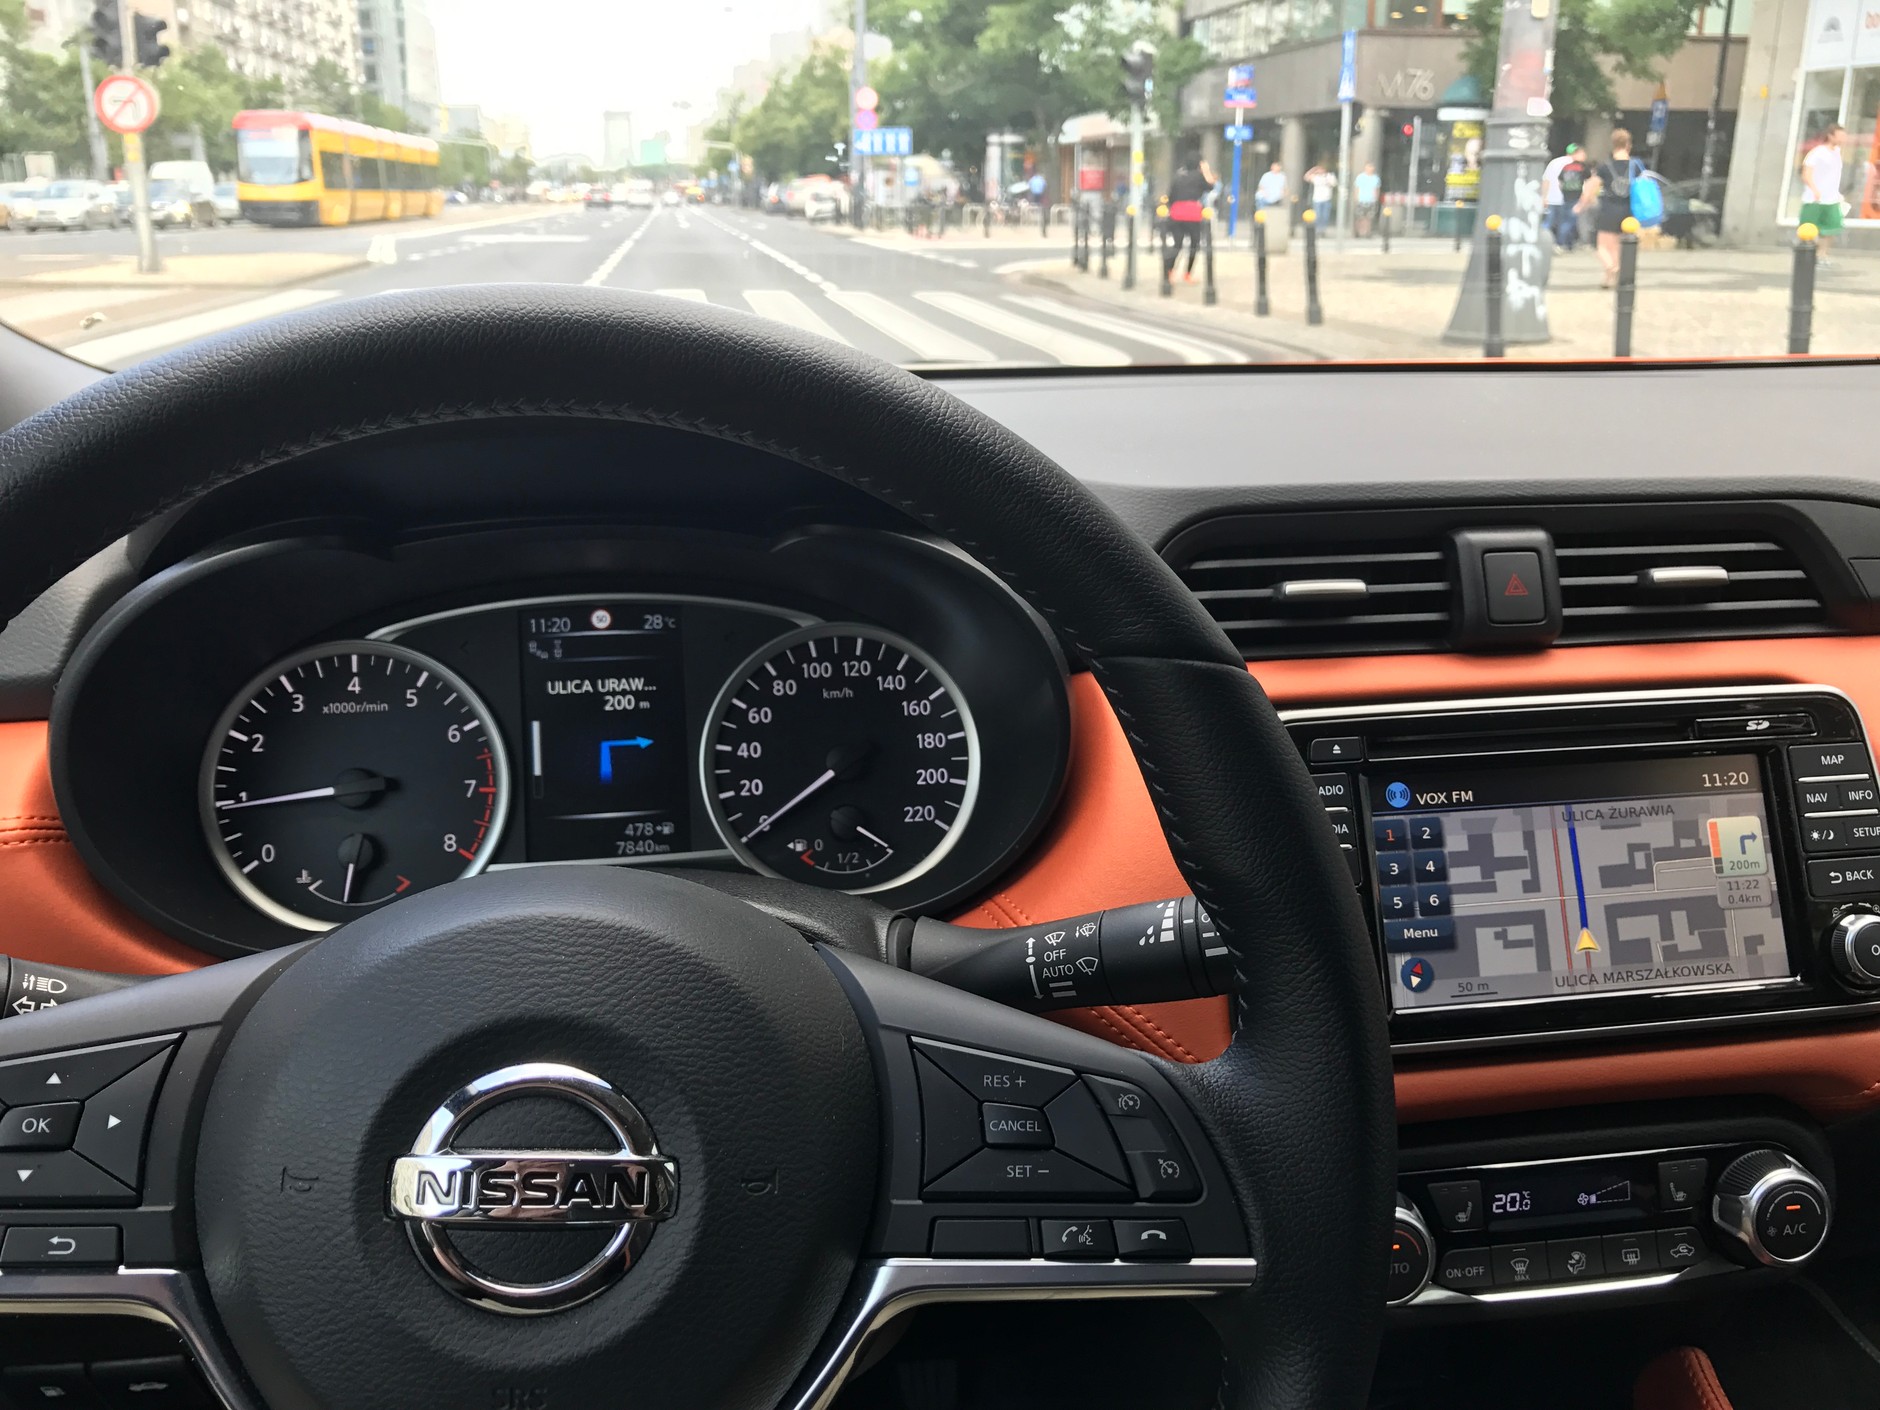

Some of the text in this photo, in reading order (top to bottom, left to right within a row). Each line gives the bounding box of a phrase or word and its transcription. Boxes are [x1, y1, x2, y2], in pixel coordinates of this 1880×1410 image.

[530, 617, 571, 633] 11:20
[801, 662, 832, 679] 100
[842, 660, 871, 677] 120
[347, 676, 361, 694] 4
[547, 680, 593, 695] ULICA
[772, 680, 797, 696] 80
[876, 675, 906, 691] 140
[406, 689, 418, 708] 5
[822, 688, 853, 699] km/h
[292, 694, 305, 712] 3
[322, 701, 388, 715] x1000r/min
[604, 695, 650, 711] 200 m
[901, 700, 931, 717] 160
[748, 707, 772, 724] 60
[447, 725, 461, 743] 6
[916, 733, 946, 749] 180
[251, 733, 264, 752] 2
[737, 742, 762, 759] 40
[1821, 755, 1844, 766] MAP
[916, 768, 948, 786] 200
[1701, 771, 1750, 787] 11:20
[464, 779, 476, 798] 7
[739, 779, 763, 796] 20
[1318, 785, 1344, 796] ADIO
[239, 791, 247, 802] 1
[1416, 790, 1474, 805] VOX FM
[1806, 793, 1828, 803] NAV
[1848, 790, 1873, 801] INFO
[904, 805, 935, 822] 220
[1561, 804, 1675, 822] ULICA ŻURAWIA
[624, 822, 654, 837] 478
[1332, 823, 1349, 834] DIA
[1386, 829, 1395, 841] 1
[1421, 827, 1431, 839] 2
[443, 834, 457, 852] 8
[814, 839, 824, 850] 0
[261, 844, 275, 863] 0
[837, 852, 859, 864] 1/2
[1389, 863, 1399, 875] 3
[1425, 860, 1436, 872] 4
[1729, 859, 1761, 872] 200m
[1845, 869, 1874, 881] BACK
[1726, 879, 1760, 891] 11:22
[1393, 897, 1403, 909] 5
[1429, 894, 1440, 906] 6
[1727, 893, 1762, 905] 0.4km
[1403, 927, 1439, 940] Menu
[1043, 949, 1067, 962] OFF
[1871, 944, 1880, 956] O
[1042, 964, 1074, 979] AUTO
[1554, 962, 1735, 988] ULICA MARSZAŁKOWSKA
[1458, 982, 1489, 993] 50 m
[983, 1074, 1010, 1088] RES
[22, 1117, 50, 1133] OK
[989, 1120, 1042, 1132] CANCEL
[1006, 1165, 1032, 1178] SET
[416, 1170, 648, 1209] NISSAN
[1783, 1220, 1807, 1236] A/C
[1394, 1262, 1410, 1274] TO
